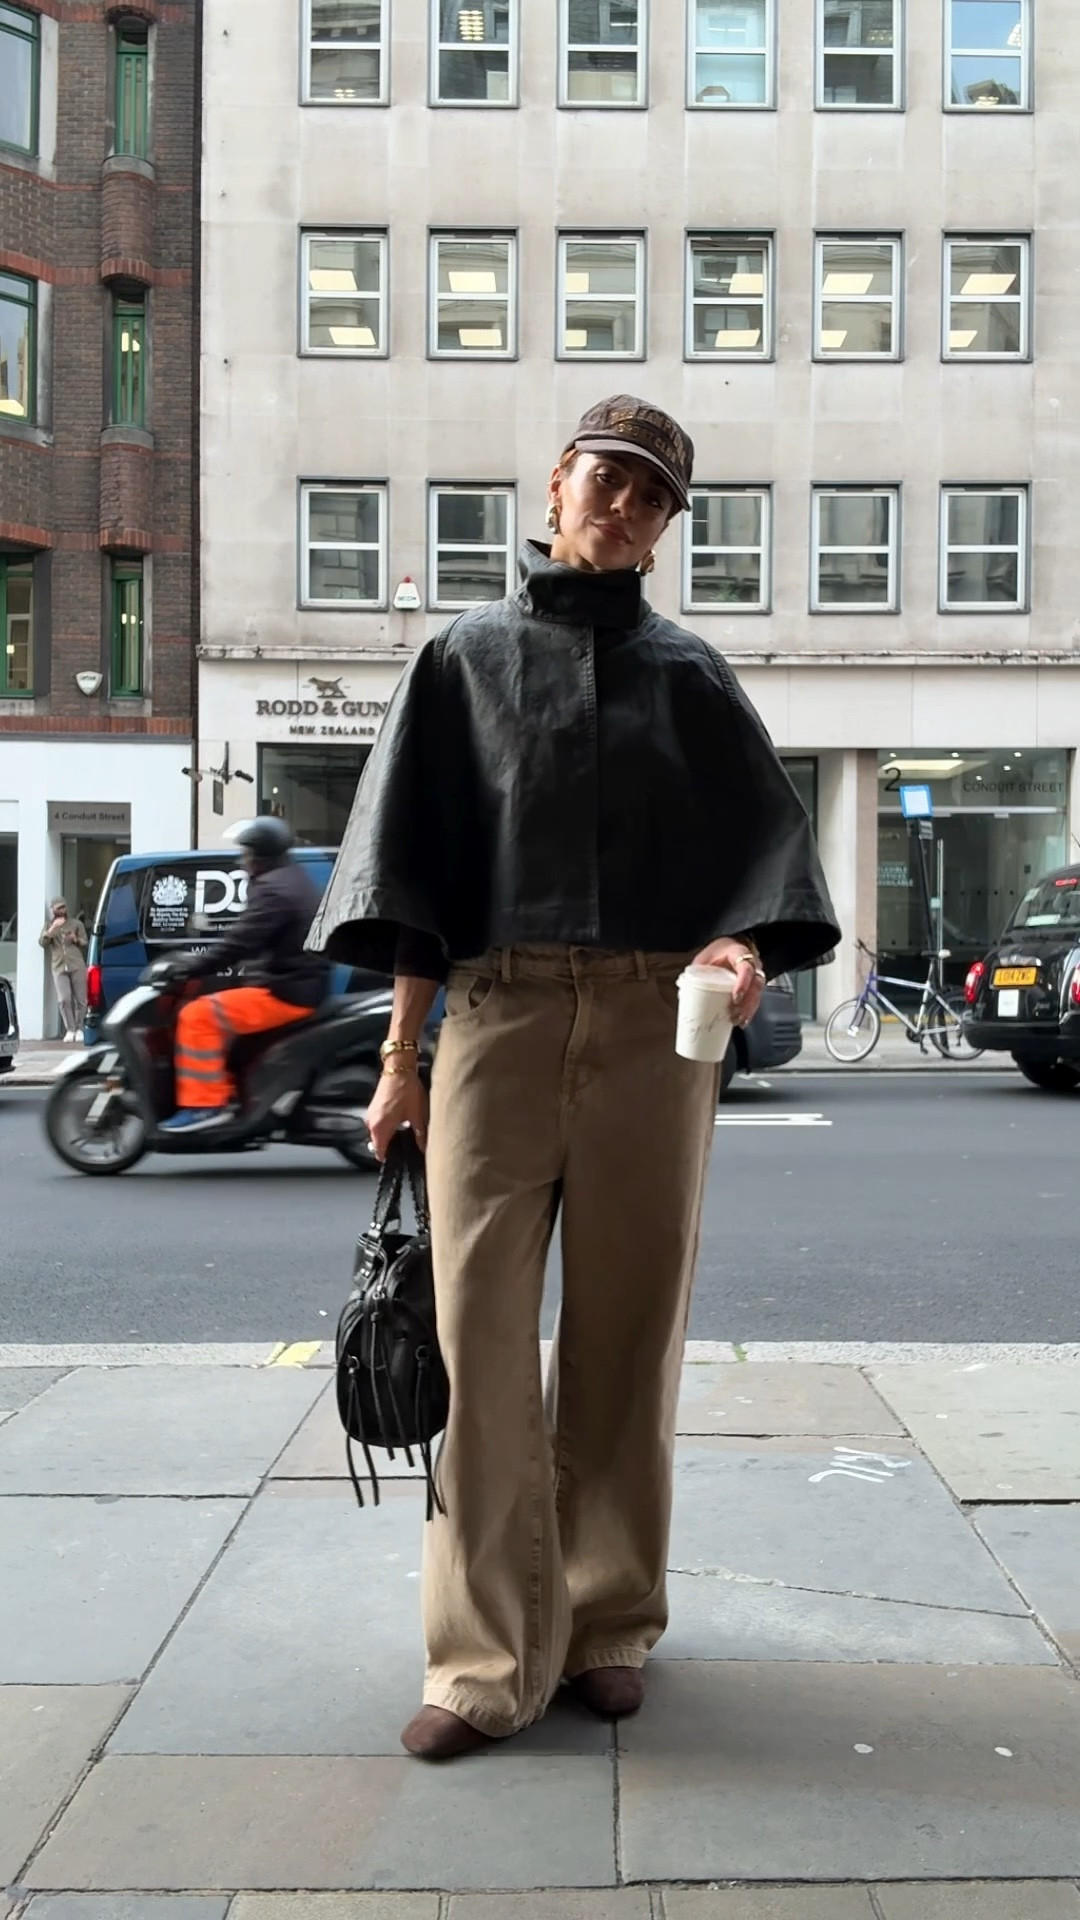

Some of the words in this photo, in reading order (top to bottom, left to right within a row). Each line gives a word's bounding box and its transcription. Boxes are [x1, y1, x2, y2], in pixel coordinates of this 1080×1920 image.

[256, 700, 318, 716] RODD
[322, 700, 339, 716] &
[289, 726, 315, 735] NEW
[320, 726, 375, 736] ZEALAND
[884, 767, 901, 792] 2
[963, 782, 1015, 793] CONDUIT
[1018, 782, 1063, 793] STREET
[62, 811, 97, 820] Conduit
[99, 811, 125, 820] Street
